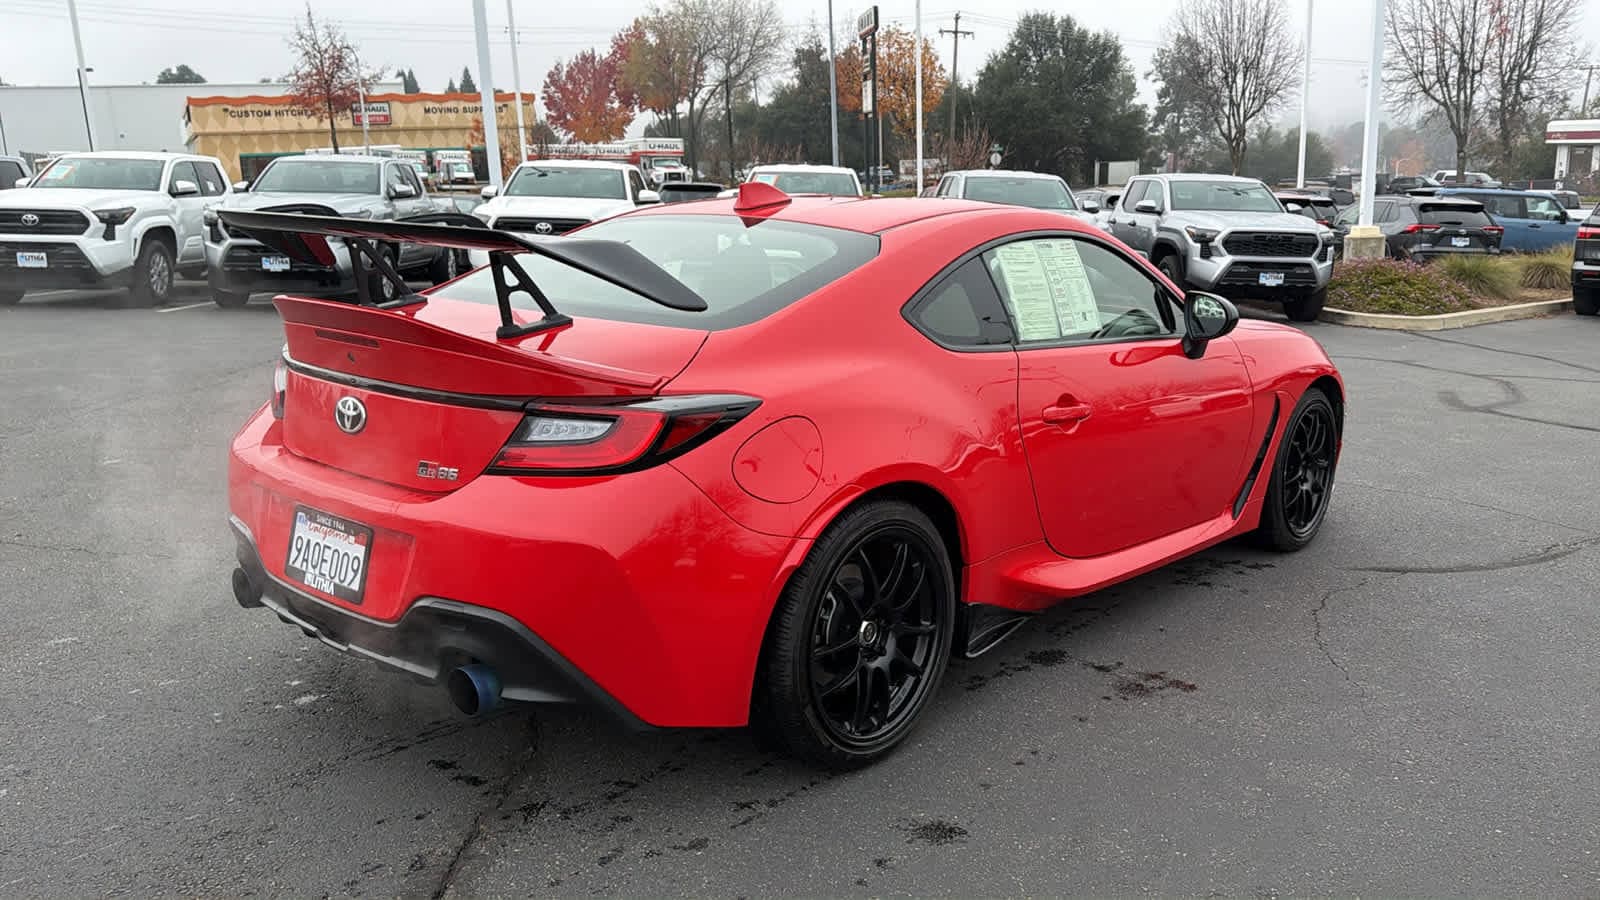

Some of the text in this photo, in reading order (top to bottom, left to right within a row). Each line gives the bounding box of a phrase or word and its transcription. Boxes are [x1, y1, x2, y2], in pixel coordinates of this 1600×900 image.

[424, 106, 459, 114] MOVING
[316, 513, 331, 528] SINCE
[292, 535, 361, 587] 9AQE009
[312, 574, 335, 596] LITHIA
